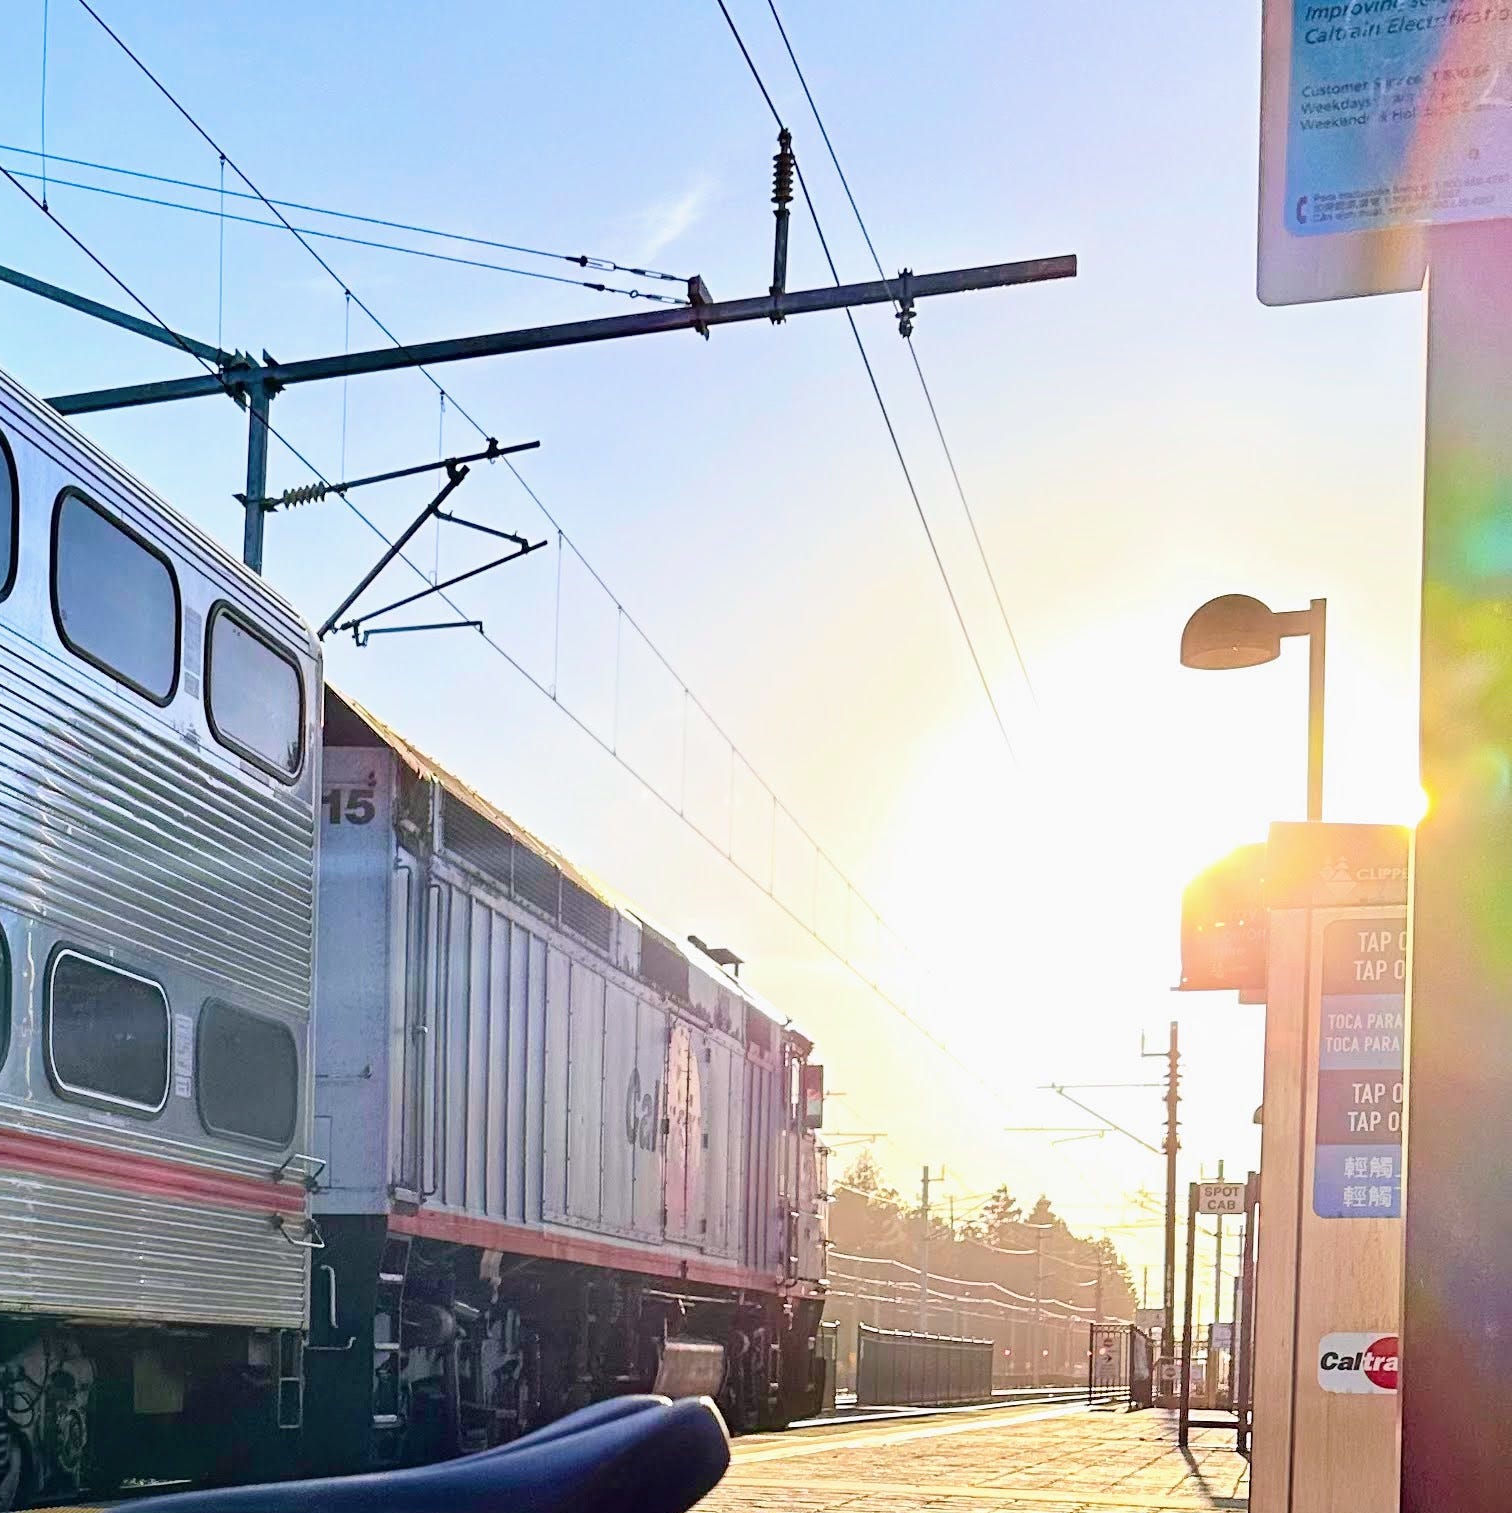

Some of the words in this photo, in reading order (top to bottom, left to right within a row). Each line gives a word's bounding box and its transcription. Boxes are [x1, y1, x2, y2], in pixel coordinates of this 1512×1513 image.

[1358, 931, 1392, 953] TAP
[1353, 960, 1388, 981] TAP
[1328, 1013, 1362, 1030] TOCA
[1367, 1013, 1403, 1029] PARA
[1326, 1037, 1360, 1053] TOCA
[1364, 1036, 1400, 1052] PARA
[1352, 1083, 1386, 1104] TAP
[1347, 1111, 1382, 1132] TAP
[1204, 1186, 1240, 1197] SPOT
[1207, 1199, 1236, 1210] CAB
